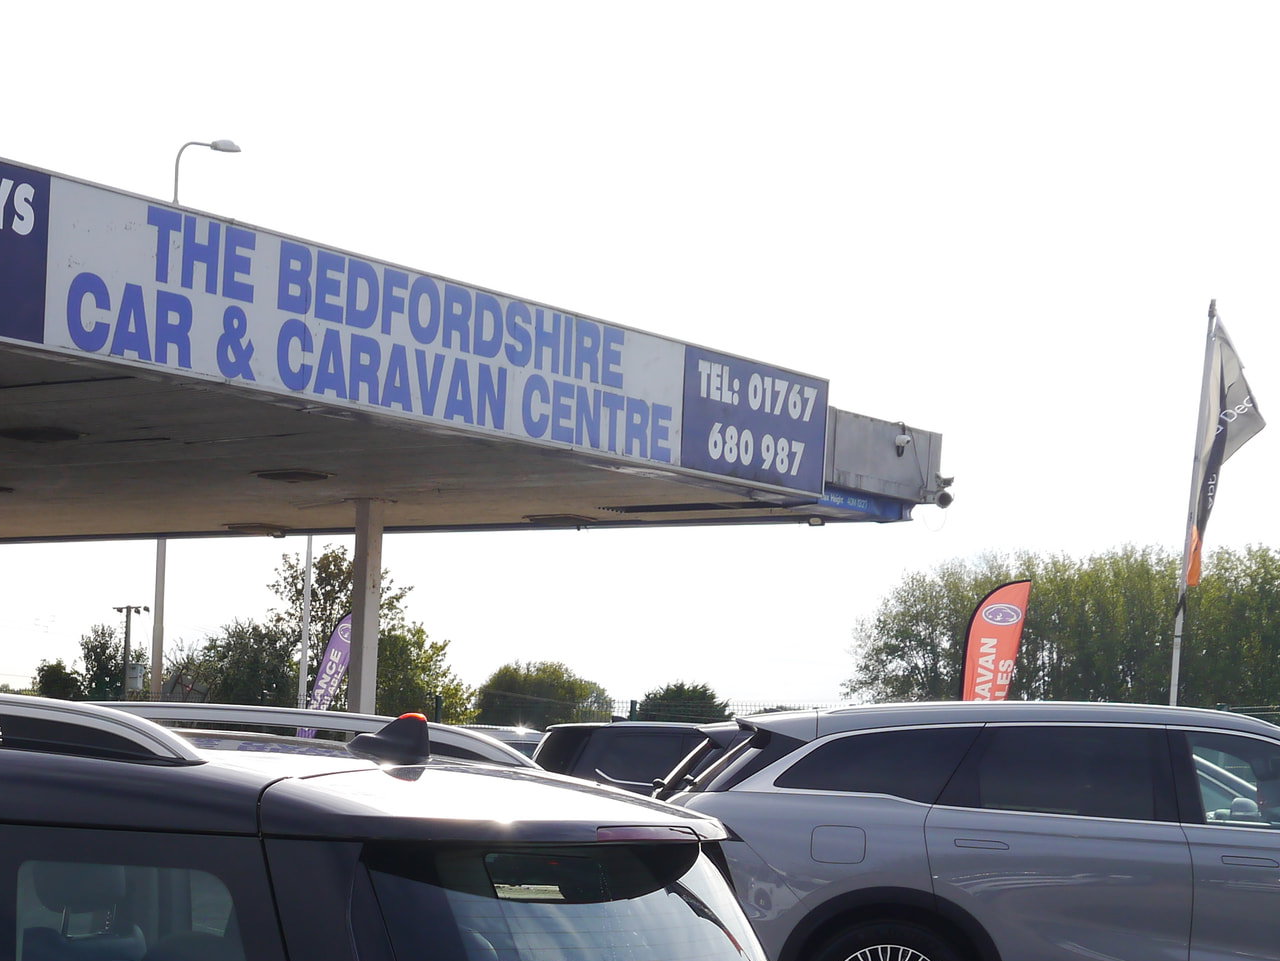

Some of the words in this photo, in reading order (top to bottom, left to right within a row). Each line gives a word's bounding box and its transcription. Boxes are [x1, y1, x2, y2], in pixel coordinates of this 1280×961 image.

[147, 204, 256, 303] THE
[277, 240, 625, 390] BEDFORDSHIRE
[66, 271, 193, 369] CAR
[216, 305, 256, 382] &
[277, 318, 507, 430] CARAVAN
[522, 374, 672, 464] CENTRE
[698, 359, 741, 406] TEL:
[748, 372, 818, 422] 01767
[708, 422, 754, 466] 680
[761, 433, 806, 476] 987
[994, 660, 1014, 701] LES
